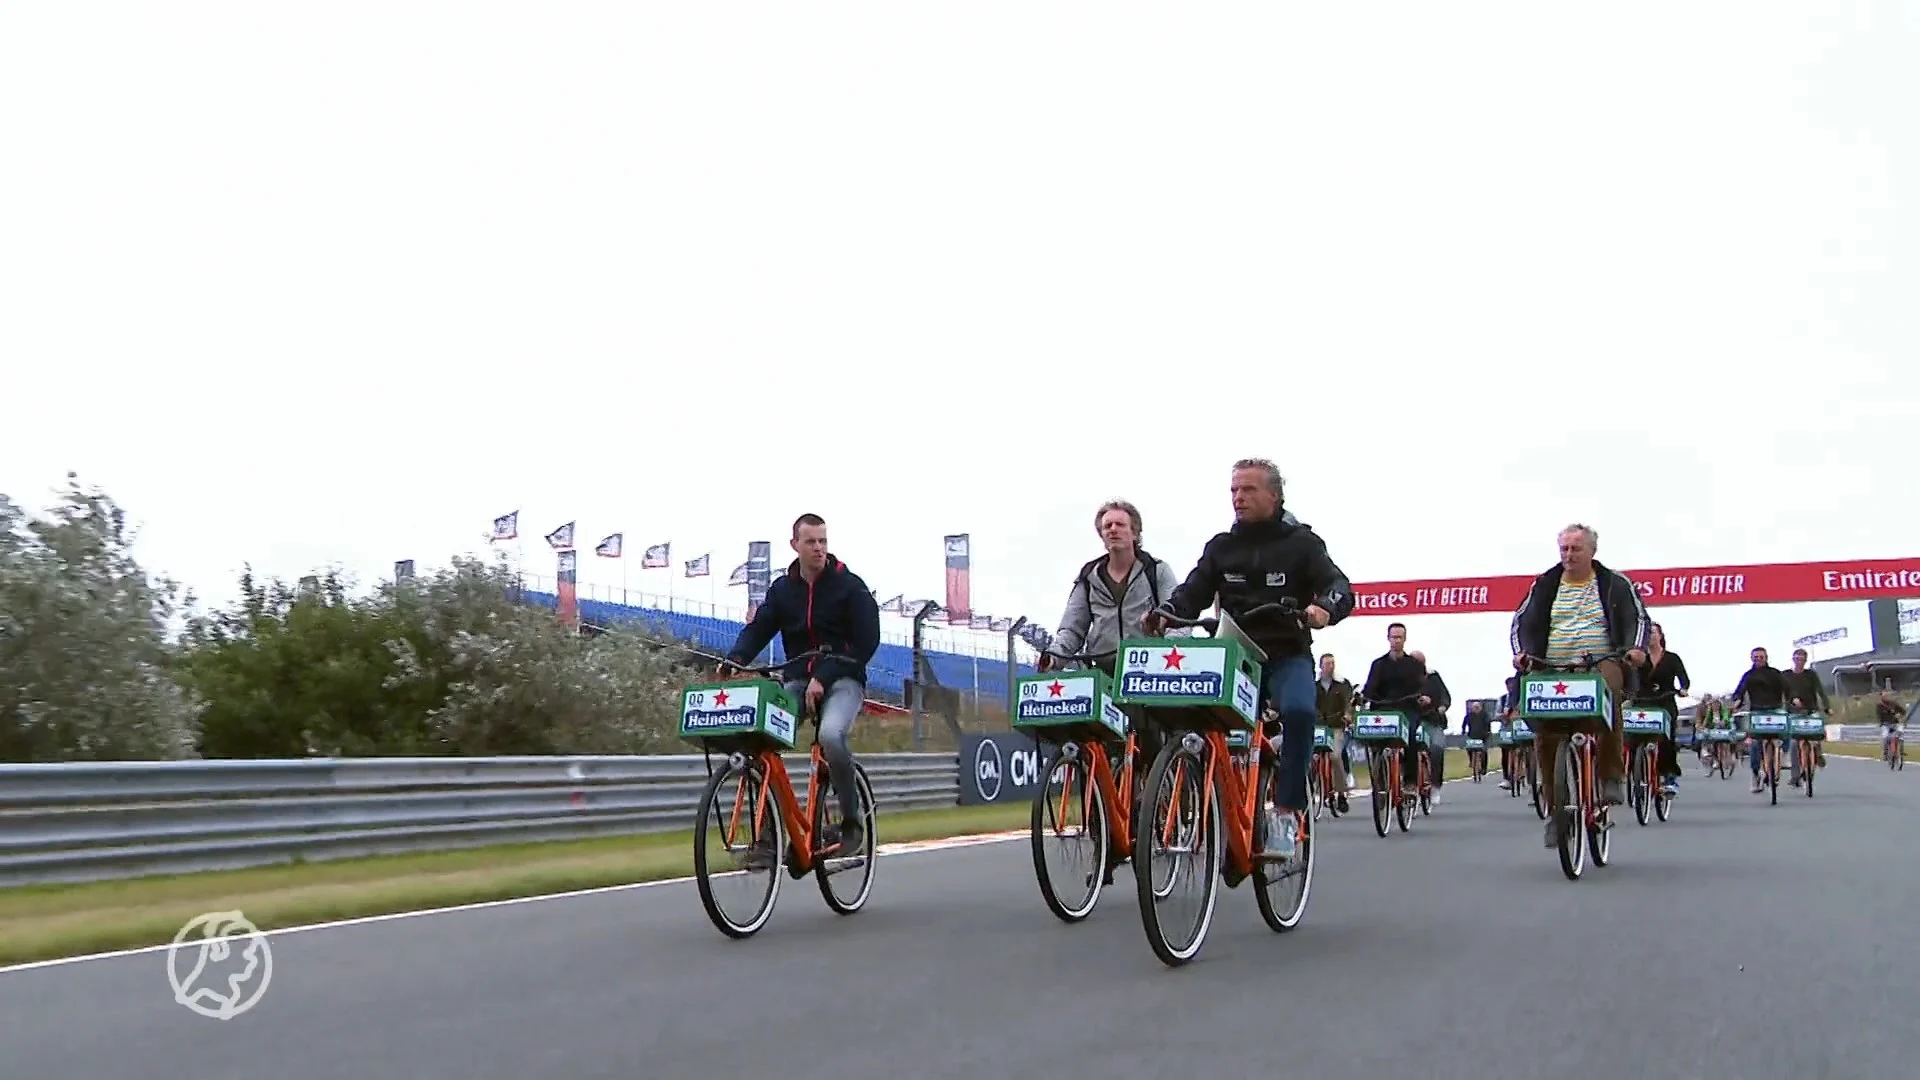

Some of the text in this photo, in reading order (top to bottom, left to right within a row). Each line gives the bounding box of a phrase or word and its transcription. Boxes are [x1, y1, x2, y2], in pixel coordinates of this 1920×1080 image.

[1662, 577, 1687, 596] FLY
[1691, 574, 1744, 594] BETTER
[1823, 569, 1920, 590] Emirate
[1354, 586, 1488, 609] irates FLY BETTER
[1127, 677, 1215, 694] Heineken
[1023, 701, 1087, 716] Heineken
[1530, 699, 1591, 710] Heineken
[688, 711, 751, 727] Heineken
